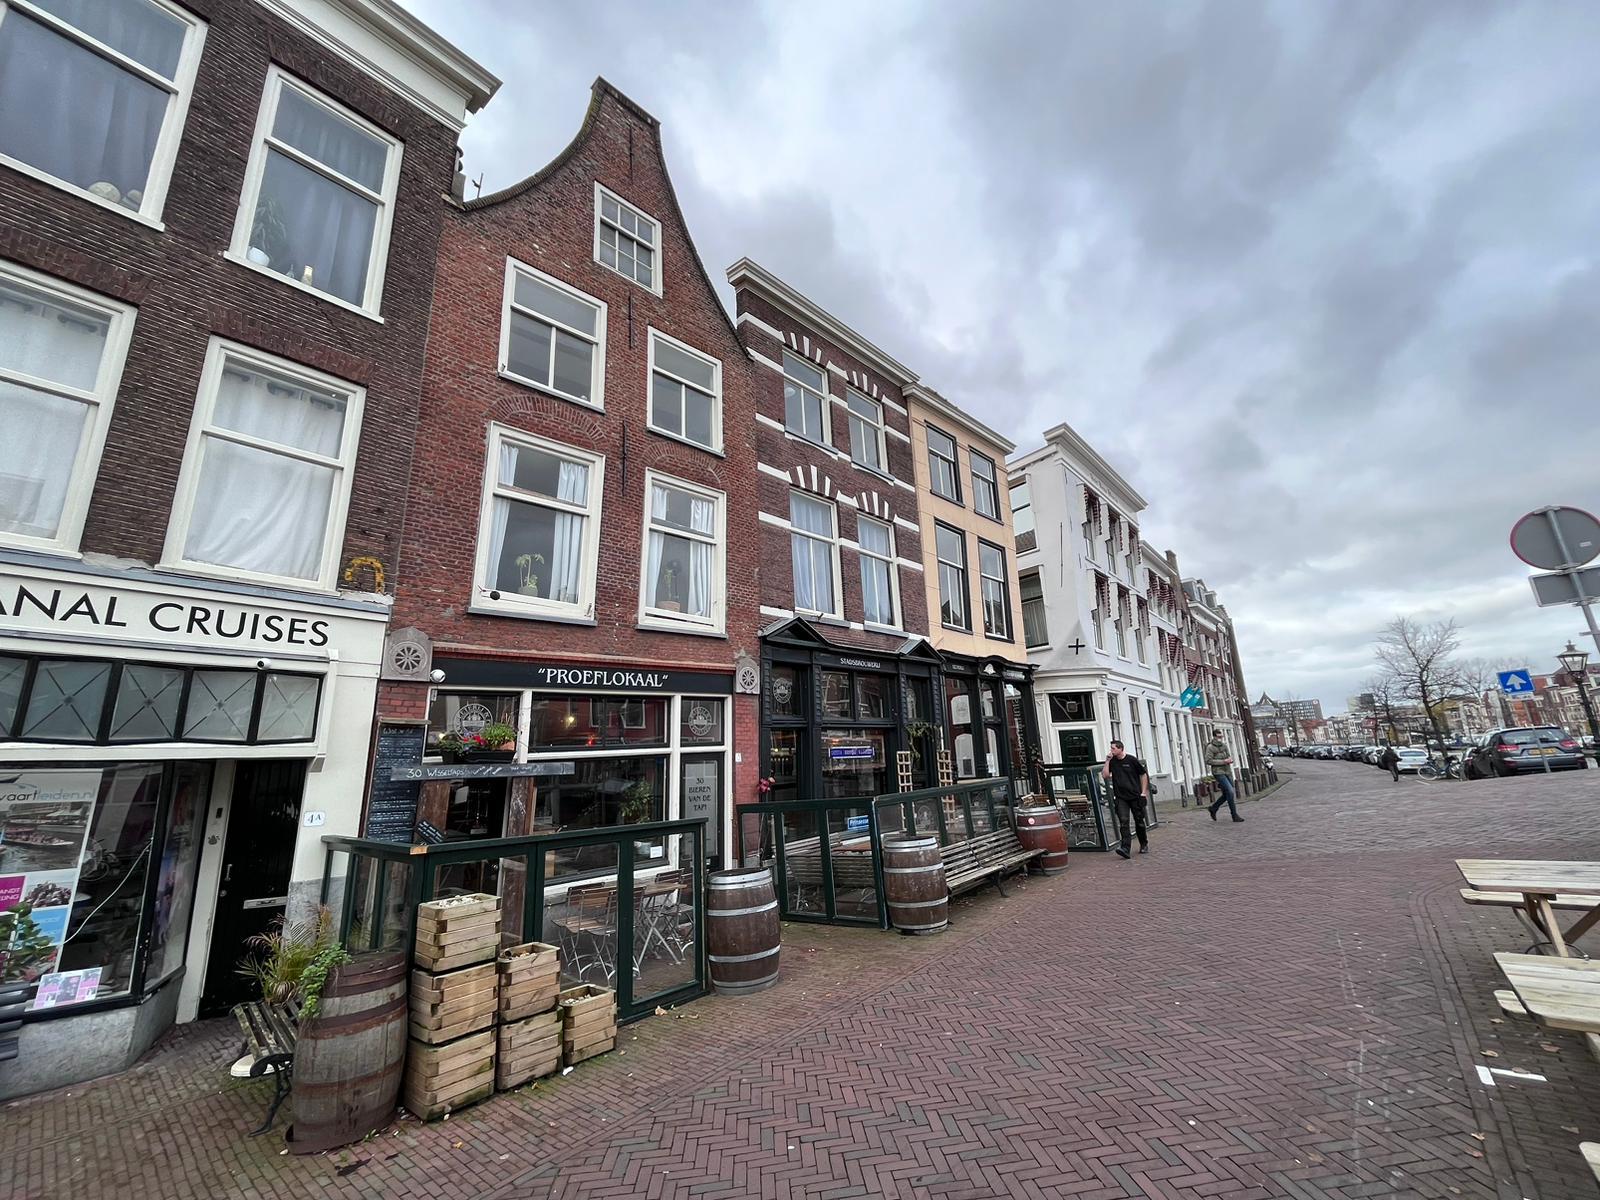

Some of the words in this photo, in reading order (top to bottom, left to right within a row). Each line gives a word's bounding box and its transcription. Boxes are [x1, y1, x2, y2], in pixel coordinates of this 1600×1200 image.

[0, 584, 127, 627] NAL
[148, 602, 330, 647] CRUISES
[406, 768, 423, 779] 30
[688, 785, 711, 794] BIEREN
